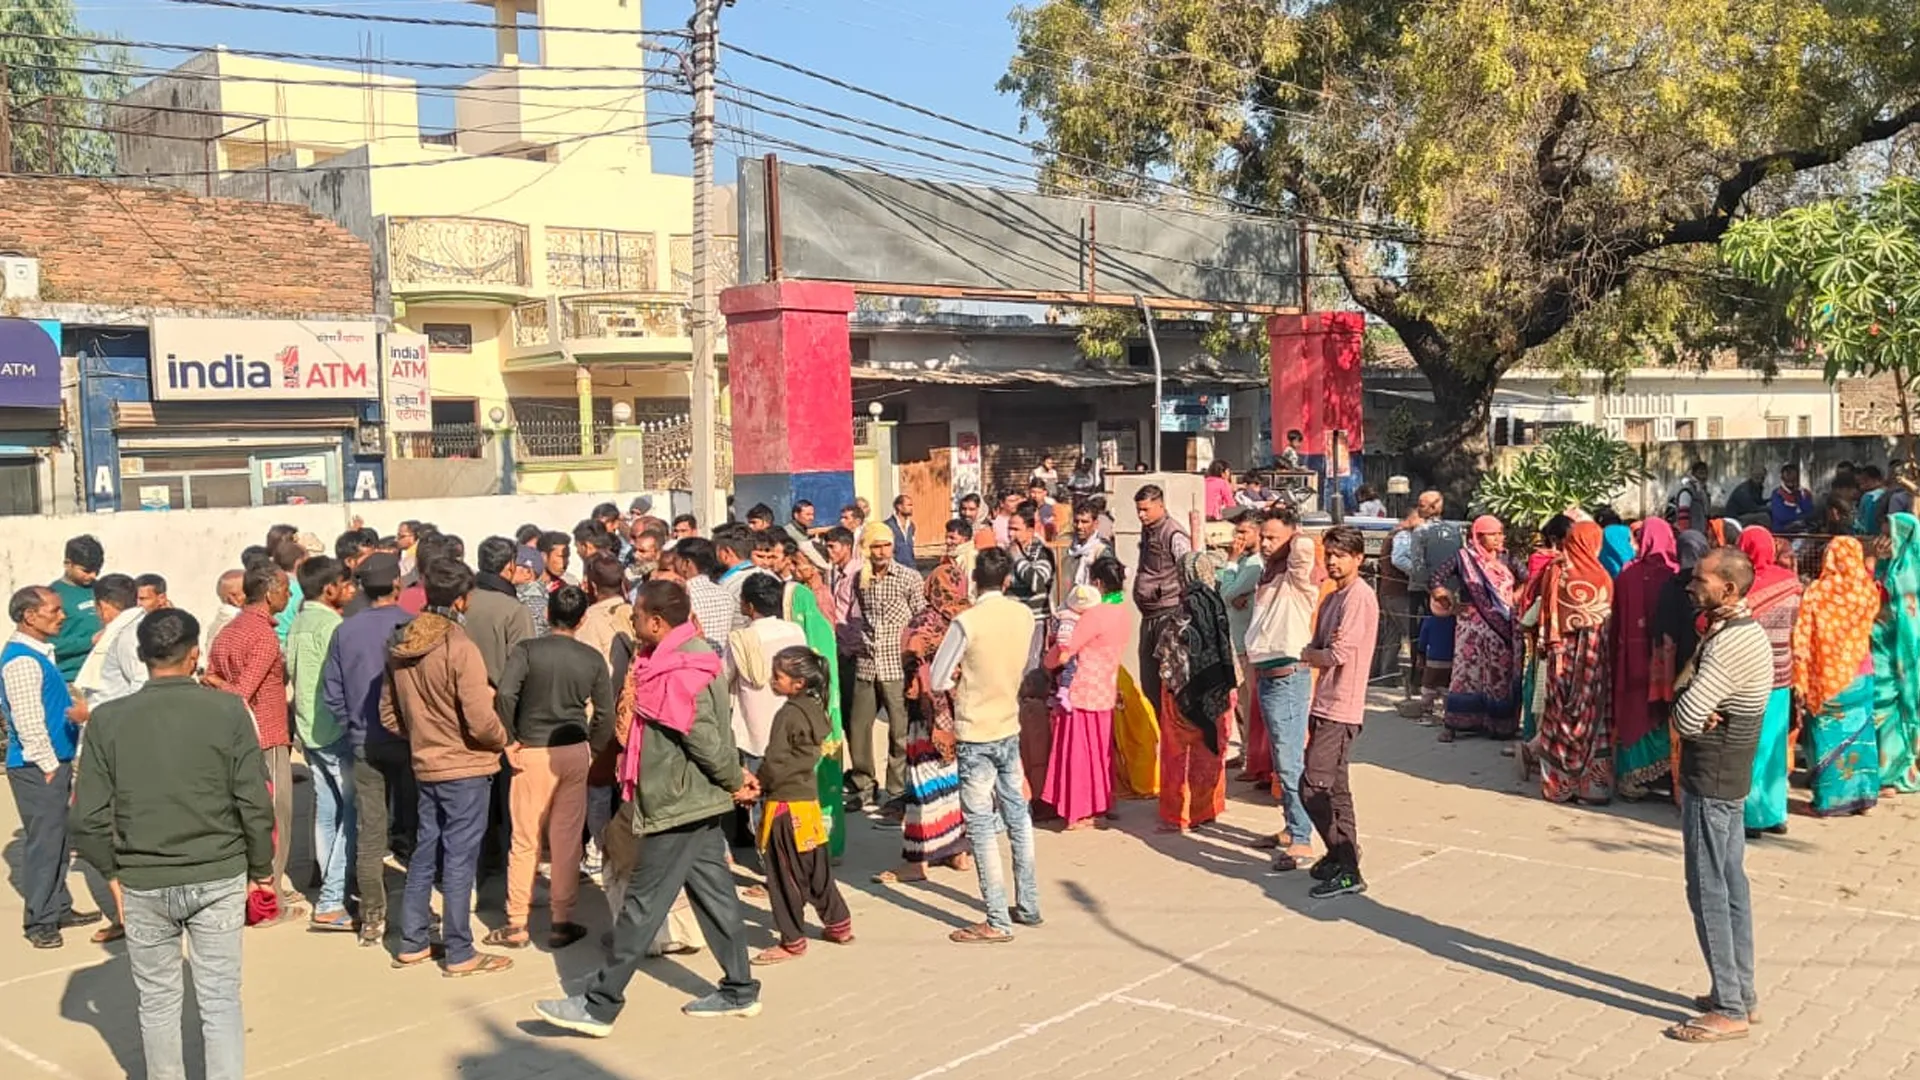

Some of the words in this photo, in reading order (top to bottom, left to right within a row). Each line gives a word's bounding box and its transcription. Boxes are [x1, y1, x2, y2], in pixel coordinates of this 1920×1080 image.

[1, 363, 36, 377] ATM
[167, 354, 271, 388] india
[306, 362, 367, 388] ATM
[392, 361, 427, 378] ATM
